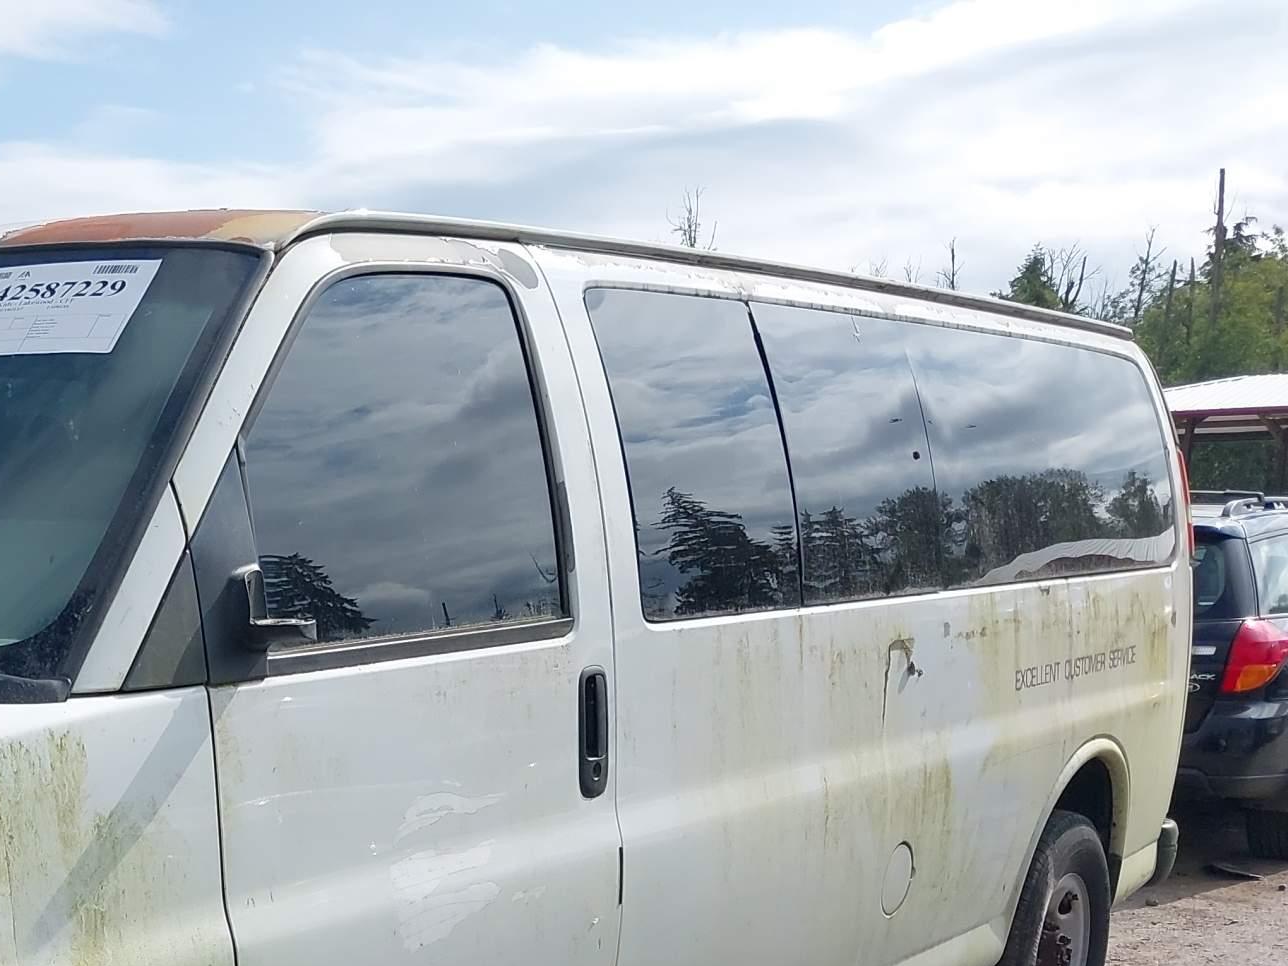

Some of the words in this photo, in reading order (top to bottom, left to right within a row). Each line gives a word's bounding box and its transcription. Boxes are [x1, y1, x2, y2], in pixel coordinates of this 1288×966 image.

[1015, 662, 1061, 691] EXCELLENT
[1064, 652, 1106, 681] CUSTOMER
[1108, 645, 1137, 669] SERVICE
[1190, 673, 1217, 681] ACK
